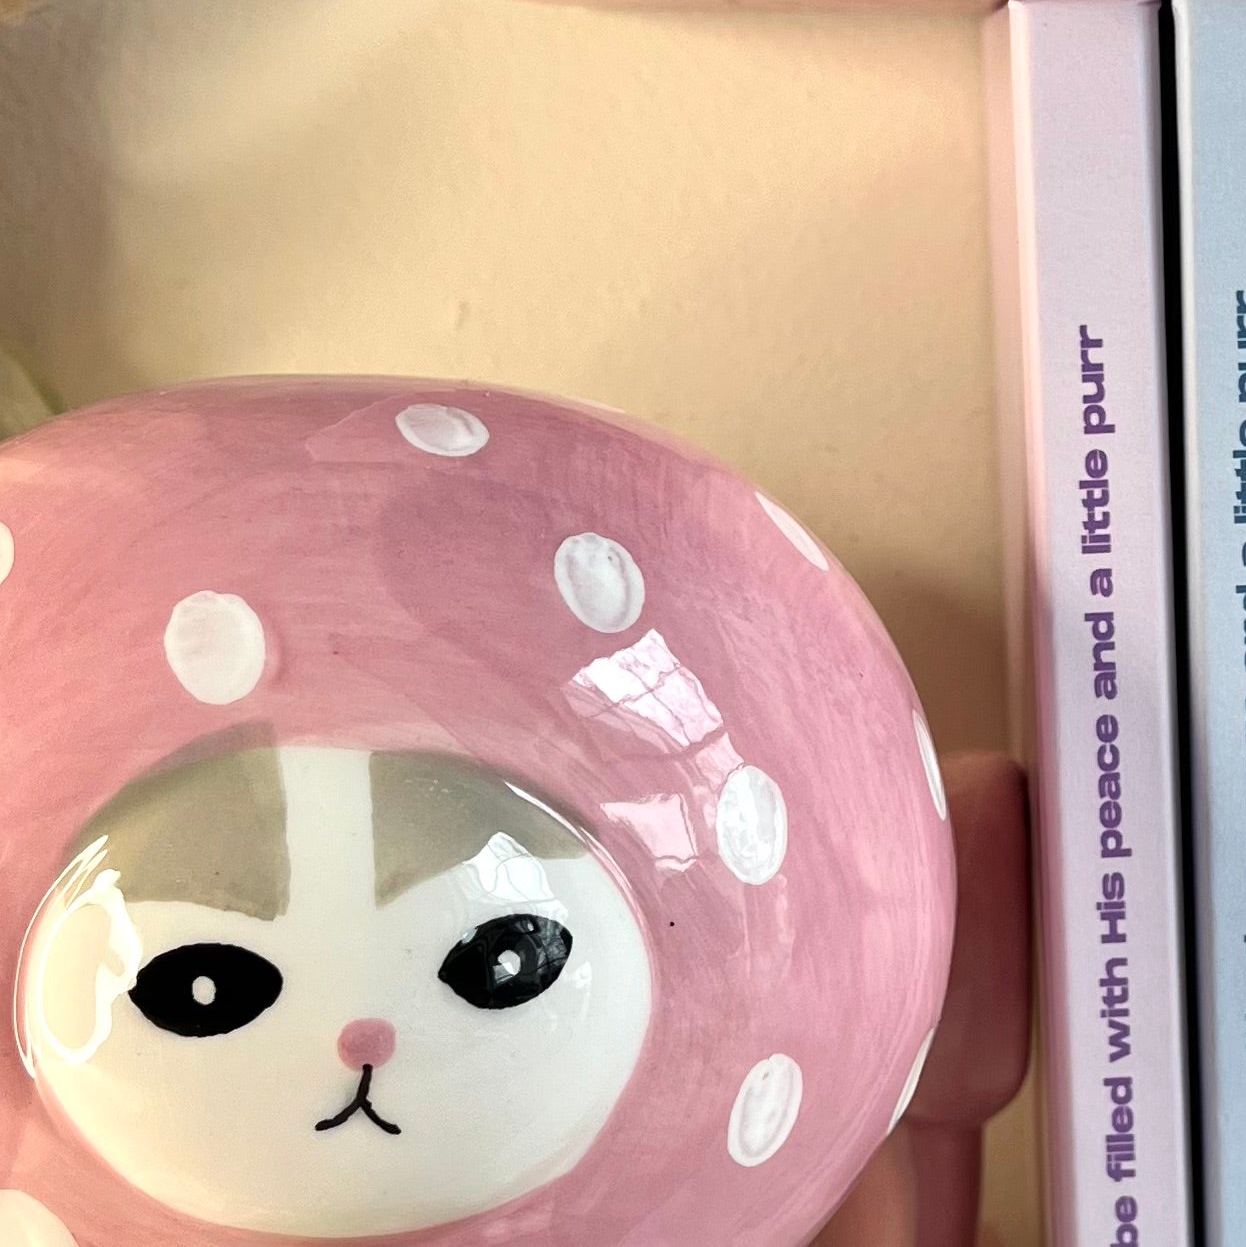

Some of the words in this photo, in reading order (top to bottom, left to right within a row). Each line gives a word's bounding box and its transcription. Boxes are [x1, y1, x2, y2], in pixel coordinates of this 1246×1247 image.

[1079, 325, 1115, 434] purr
[1078, 449, 1111, 554] little
[1090, 568, 1113, 597] a
[1084, 612, 1117, 700] and
[1096, 714, 1132, 858] peace
[1096, 872, 1126, 944] His
[1099, 958, 1131, 1063] with
[1103, 1077, 1136, 1182] filled
